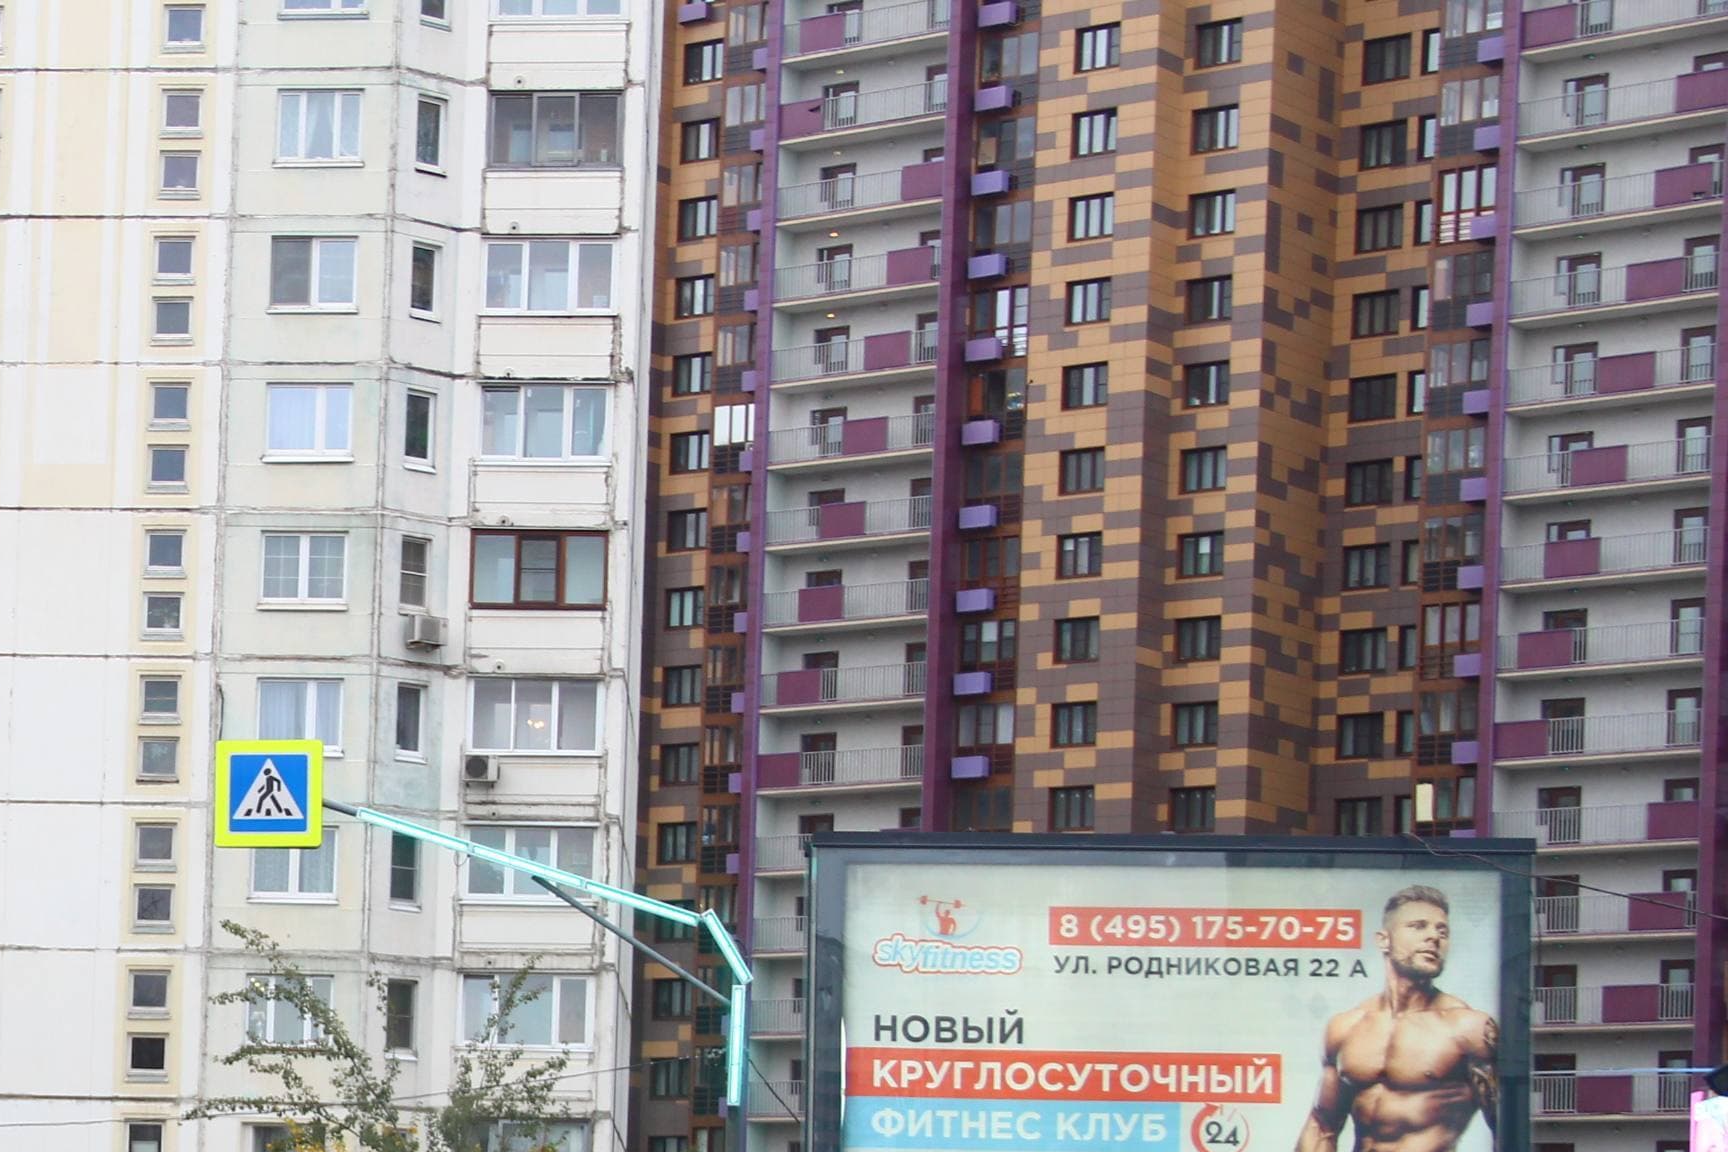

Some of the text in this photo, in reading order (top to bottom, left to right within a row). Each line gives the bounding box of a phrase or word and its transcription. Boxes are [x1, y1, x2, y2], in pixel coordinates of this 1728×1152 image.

[1060, 914, 1355, 942] 8 (495) 175-70-75
[1054, 956, 1369, 978] УЛ. РОДНИКОВАЯ 22 А
[874, 1009, 1024, 1044] НОВЫЙ
[873, 1058, 1274, 1094] КРУГЛОСУТОЧНЫЙ
[871, 1108, 1168, 1142] ФИТНЕС КЛУБ
[1205, 1121, 1241, 1146] 24
